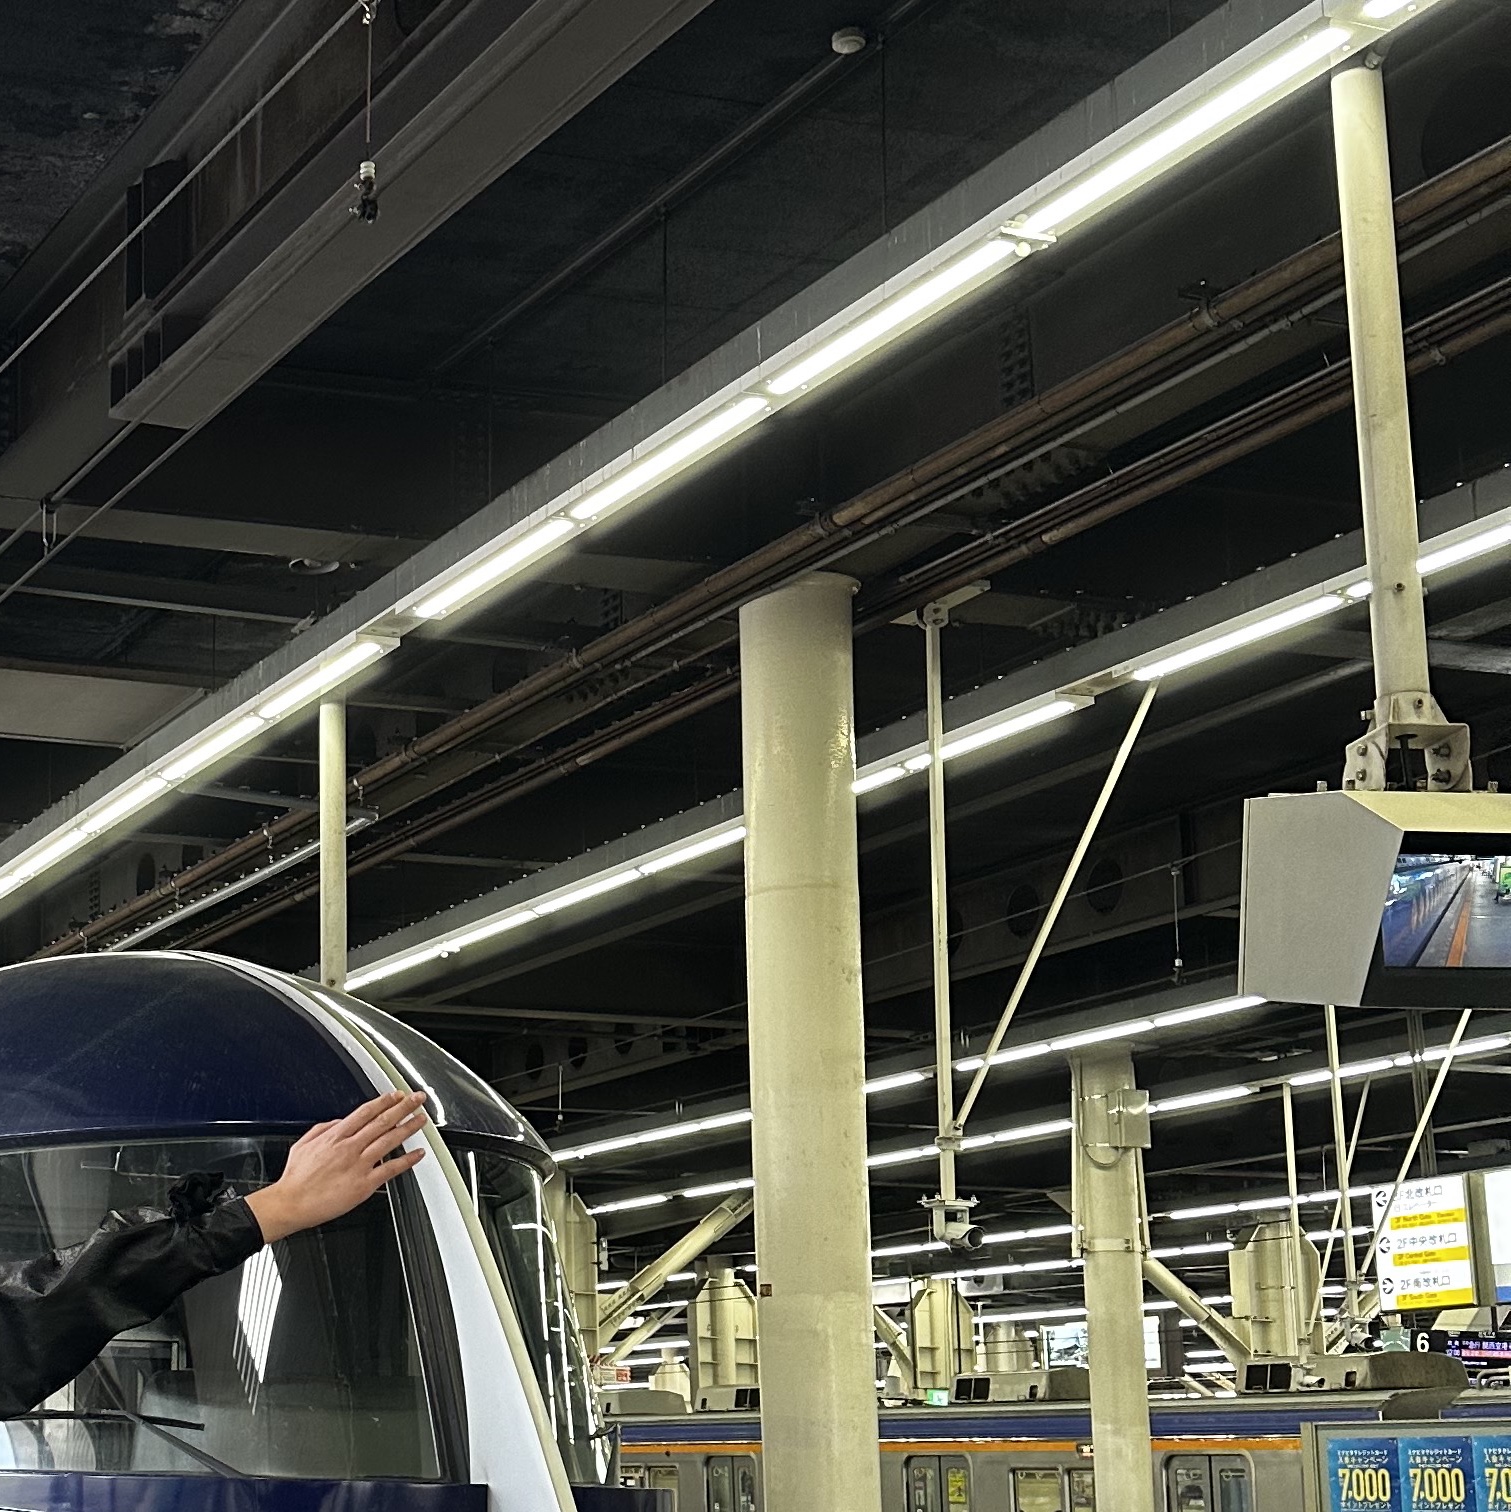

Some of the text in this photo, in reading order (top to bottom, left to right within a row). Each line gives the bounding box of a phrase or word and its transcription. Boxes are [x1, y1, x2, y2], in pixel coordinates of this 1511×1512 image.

[1397, 1232, 1457, 1250] 2F中央改札口
[1416, 1333, 1430, 1353] 6
